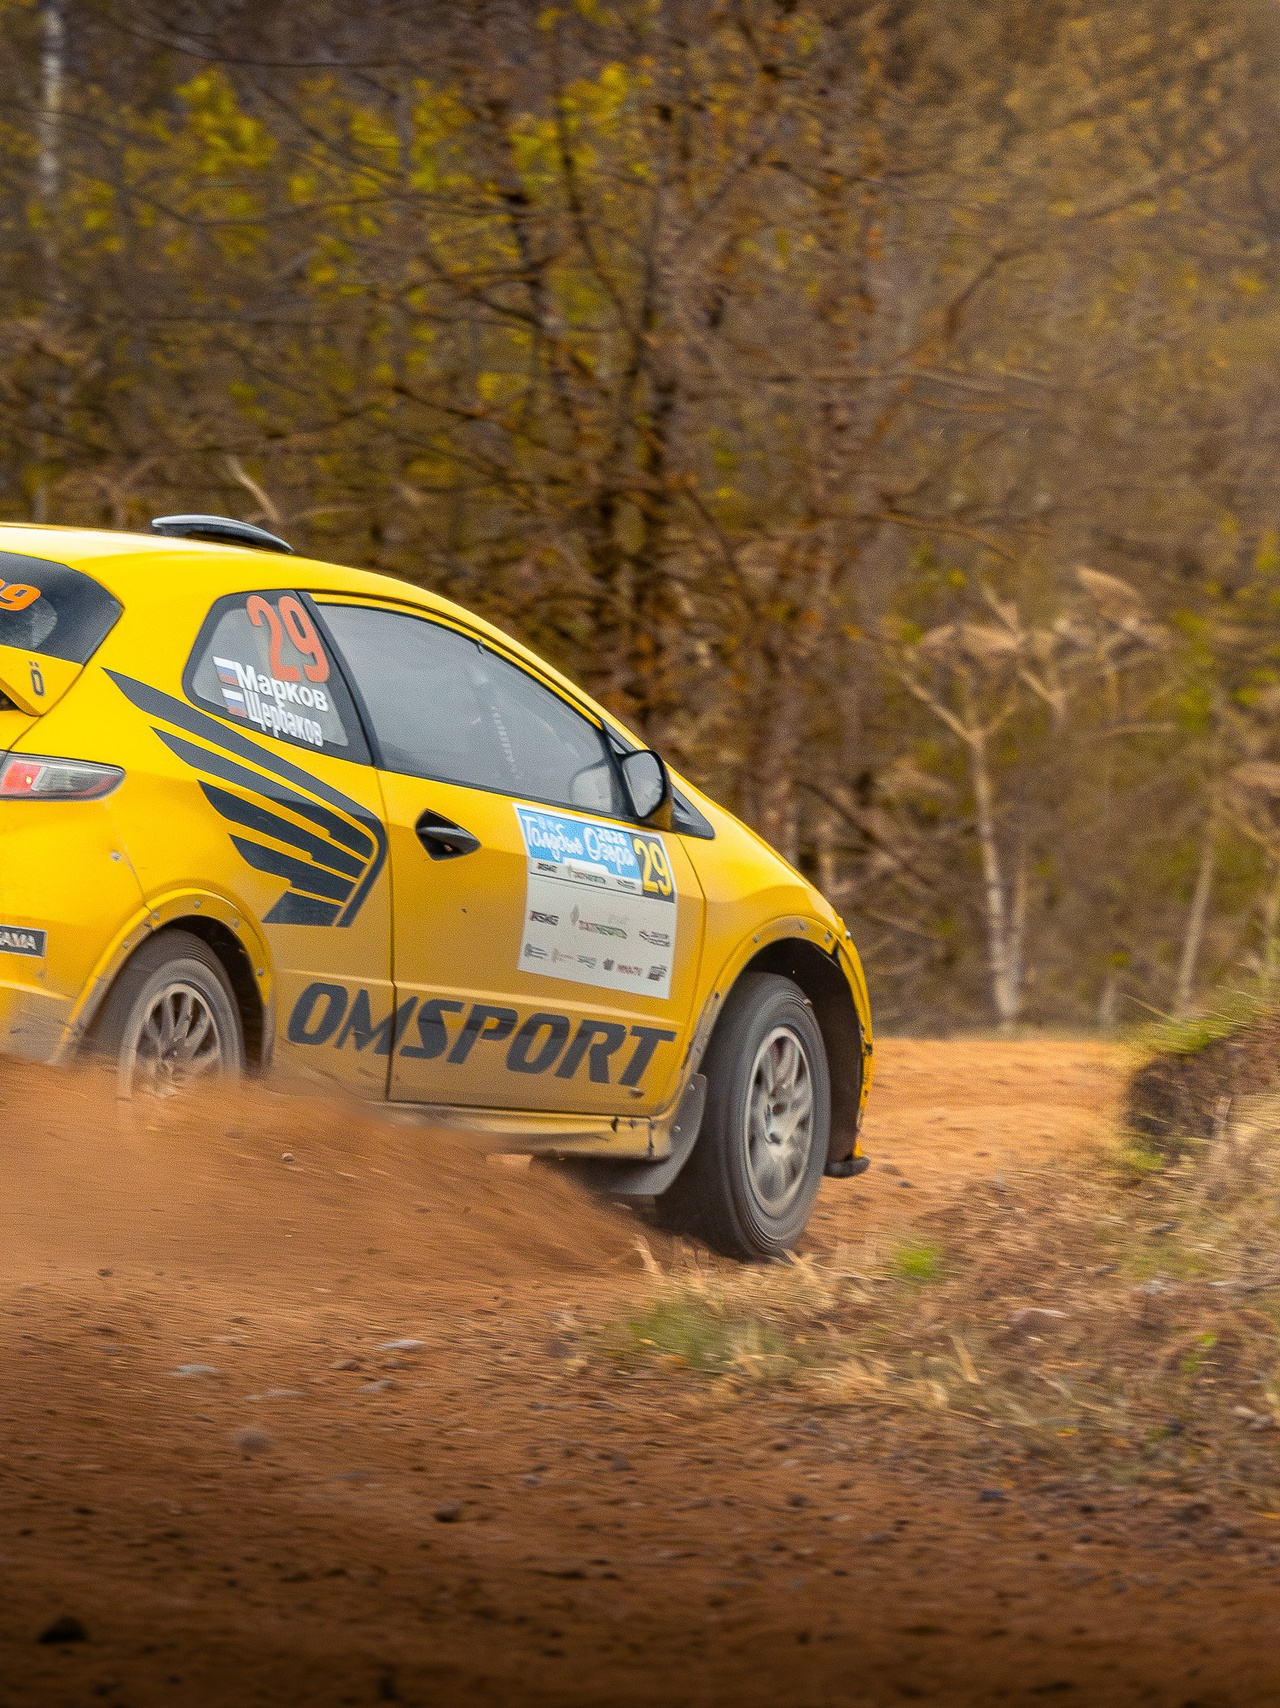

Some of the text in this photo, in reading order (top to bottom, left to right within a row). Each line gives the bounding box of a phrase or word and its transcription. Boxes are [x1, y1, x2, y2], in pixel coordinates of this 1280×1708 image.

[246, 595, 330, 683] 29
[233, 661, 329, 712] Марков
[243, 688, 324, 748] Щербаков
[633, 837, 672, 897] 29
[286, 981, 678, 1087] OMSPORT
